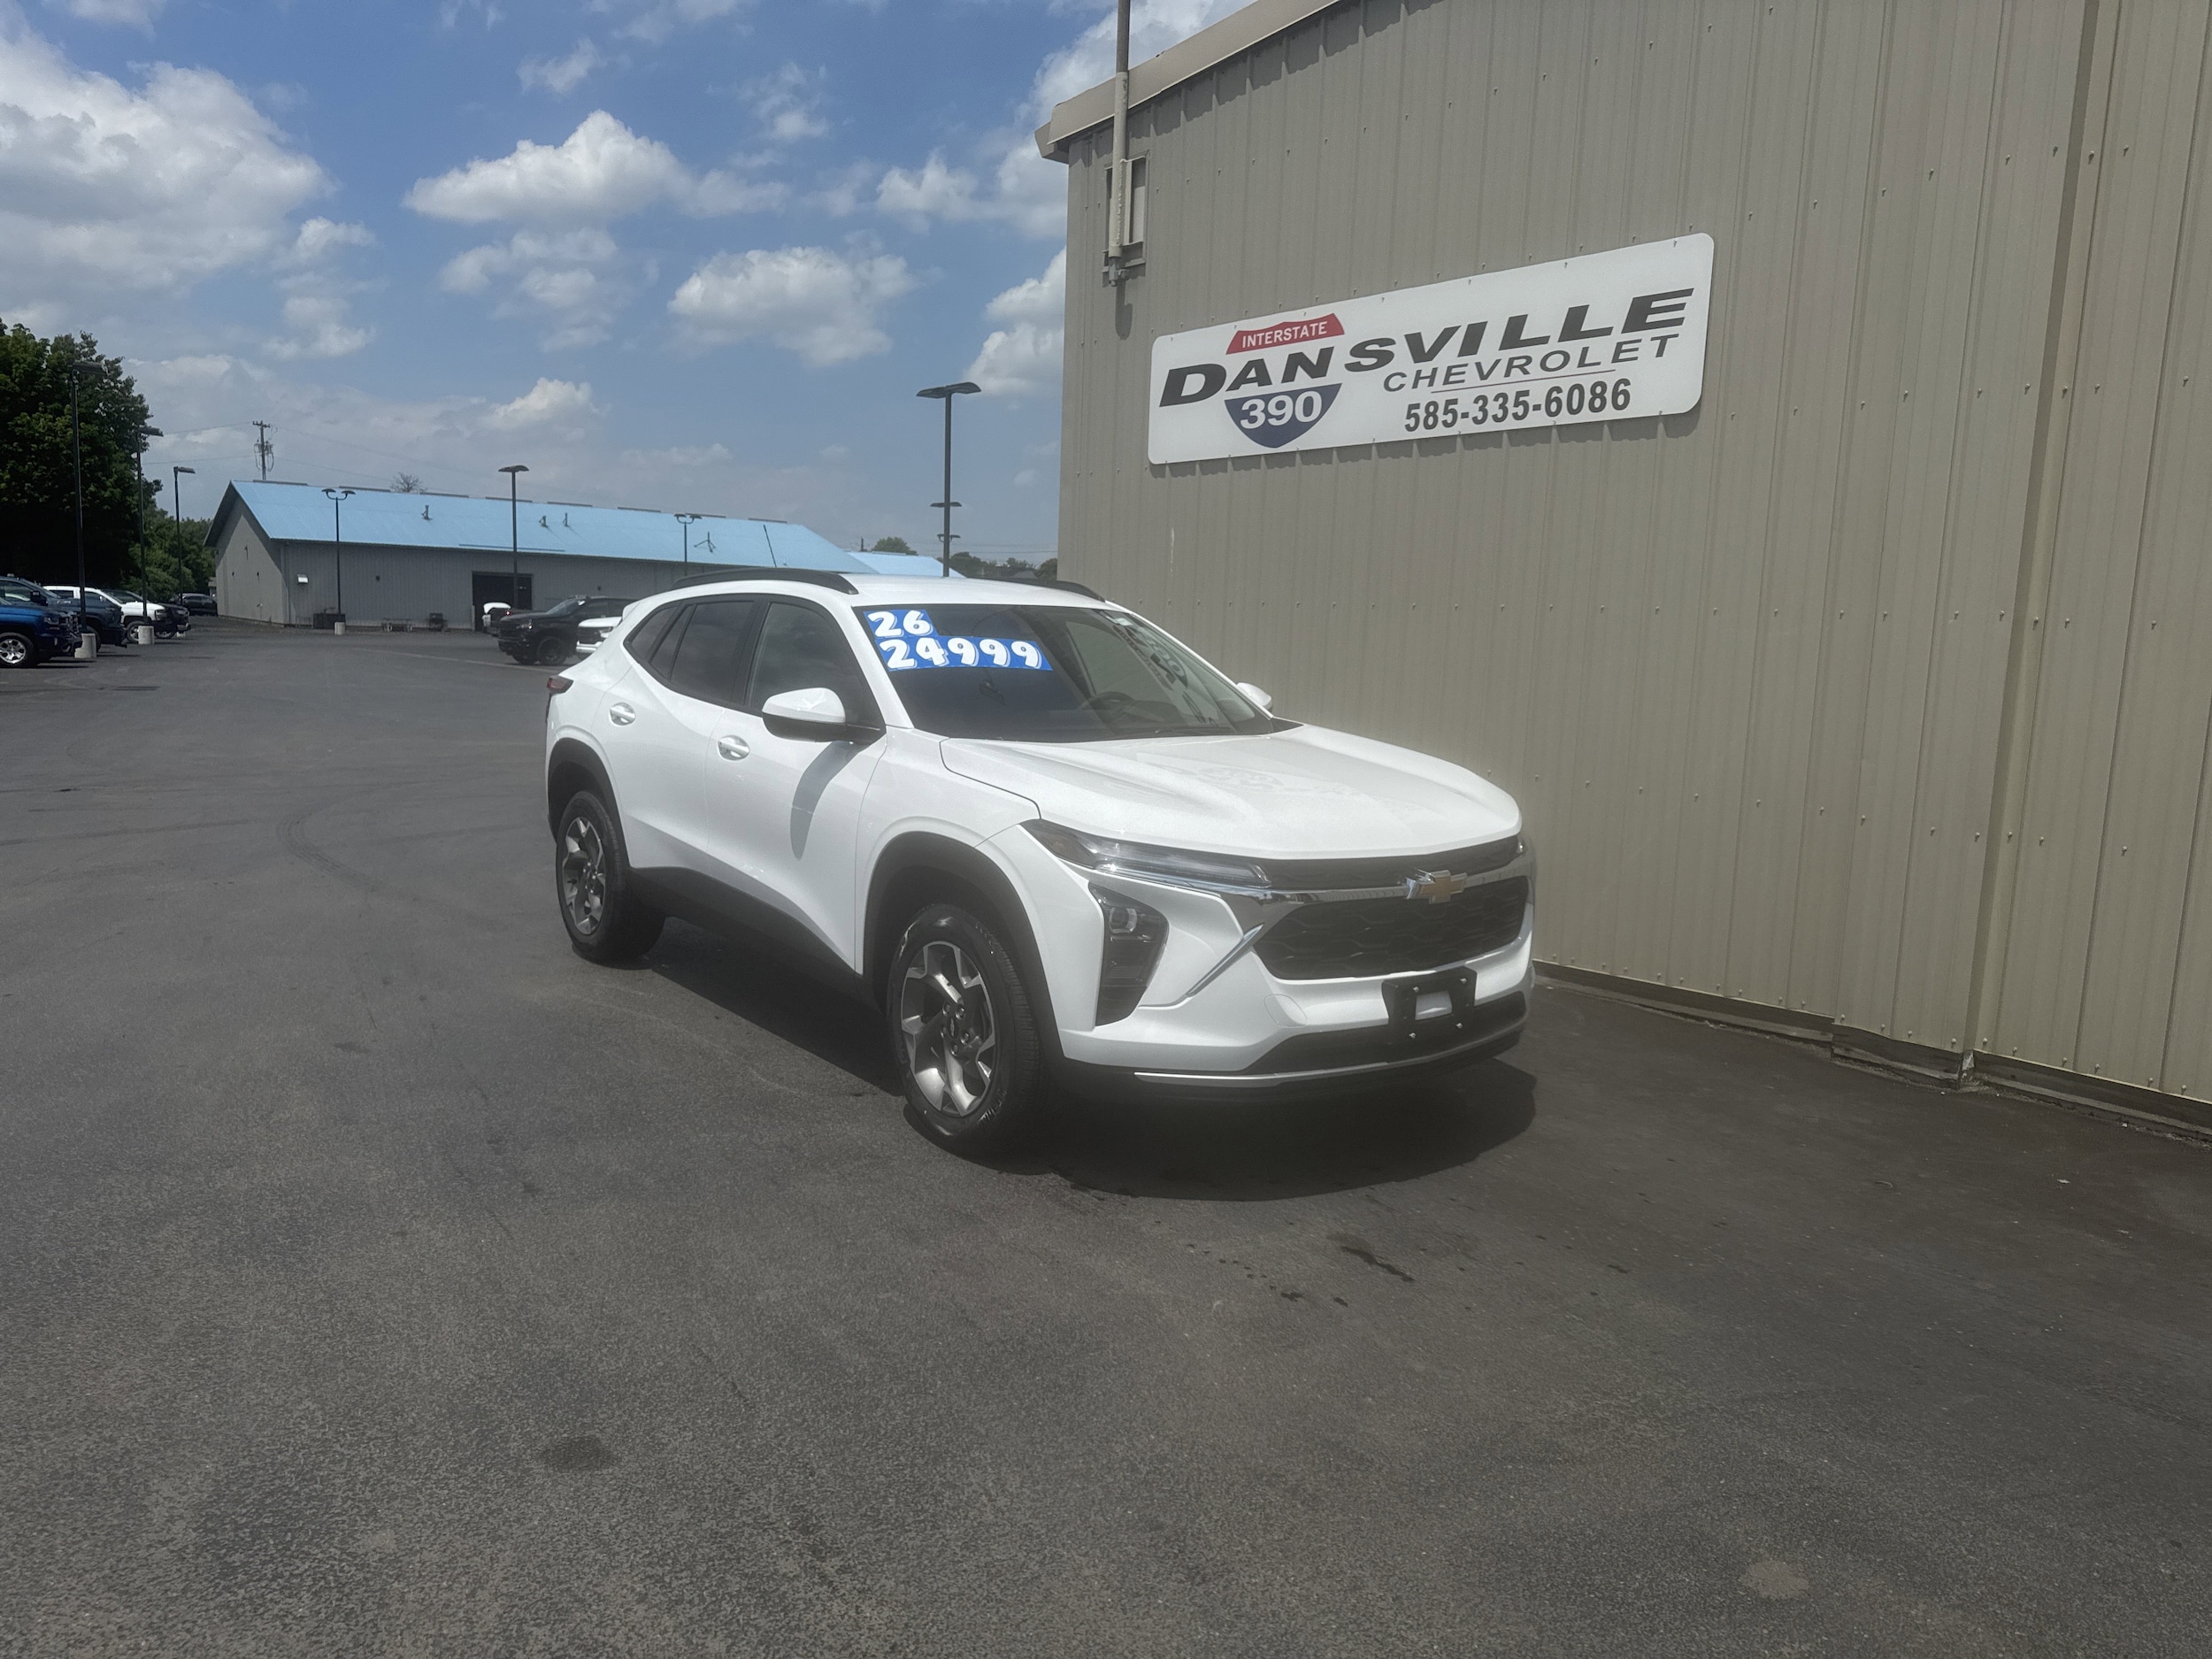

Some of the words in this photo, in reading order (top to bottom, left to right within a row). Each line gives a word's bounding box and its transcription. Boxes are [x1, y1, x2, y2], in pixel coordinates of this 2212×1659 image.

[1159, 288, 1694, 407] DANSVILLE
[1242, 321, 1327, 349] INTERSTATE
[1384, 334, 1679, 392] CHEVROLET
[1240, 390, 1323, 429] 390
[1404, 378, 1632, 432] 585-335-6086
[867, 610, 933, 637] 26
[879, 637, 1041, 669] 24999
